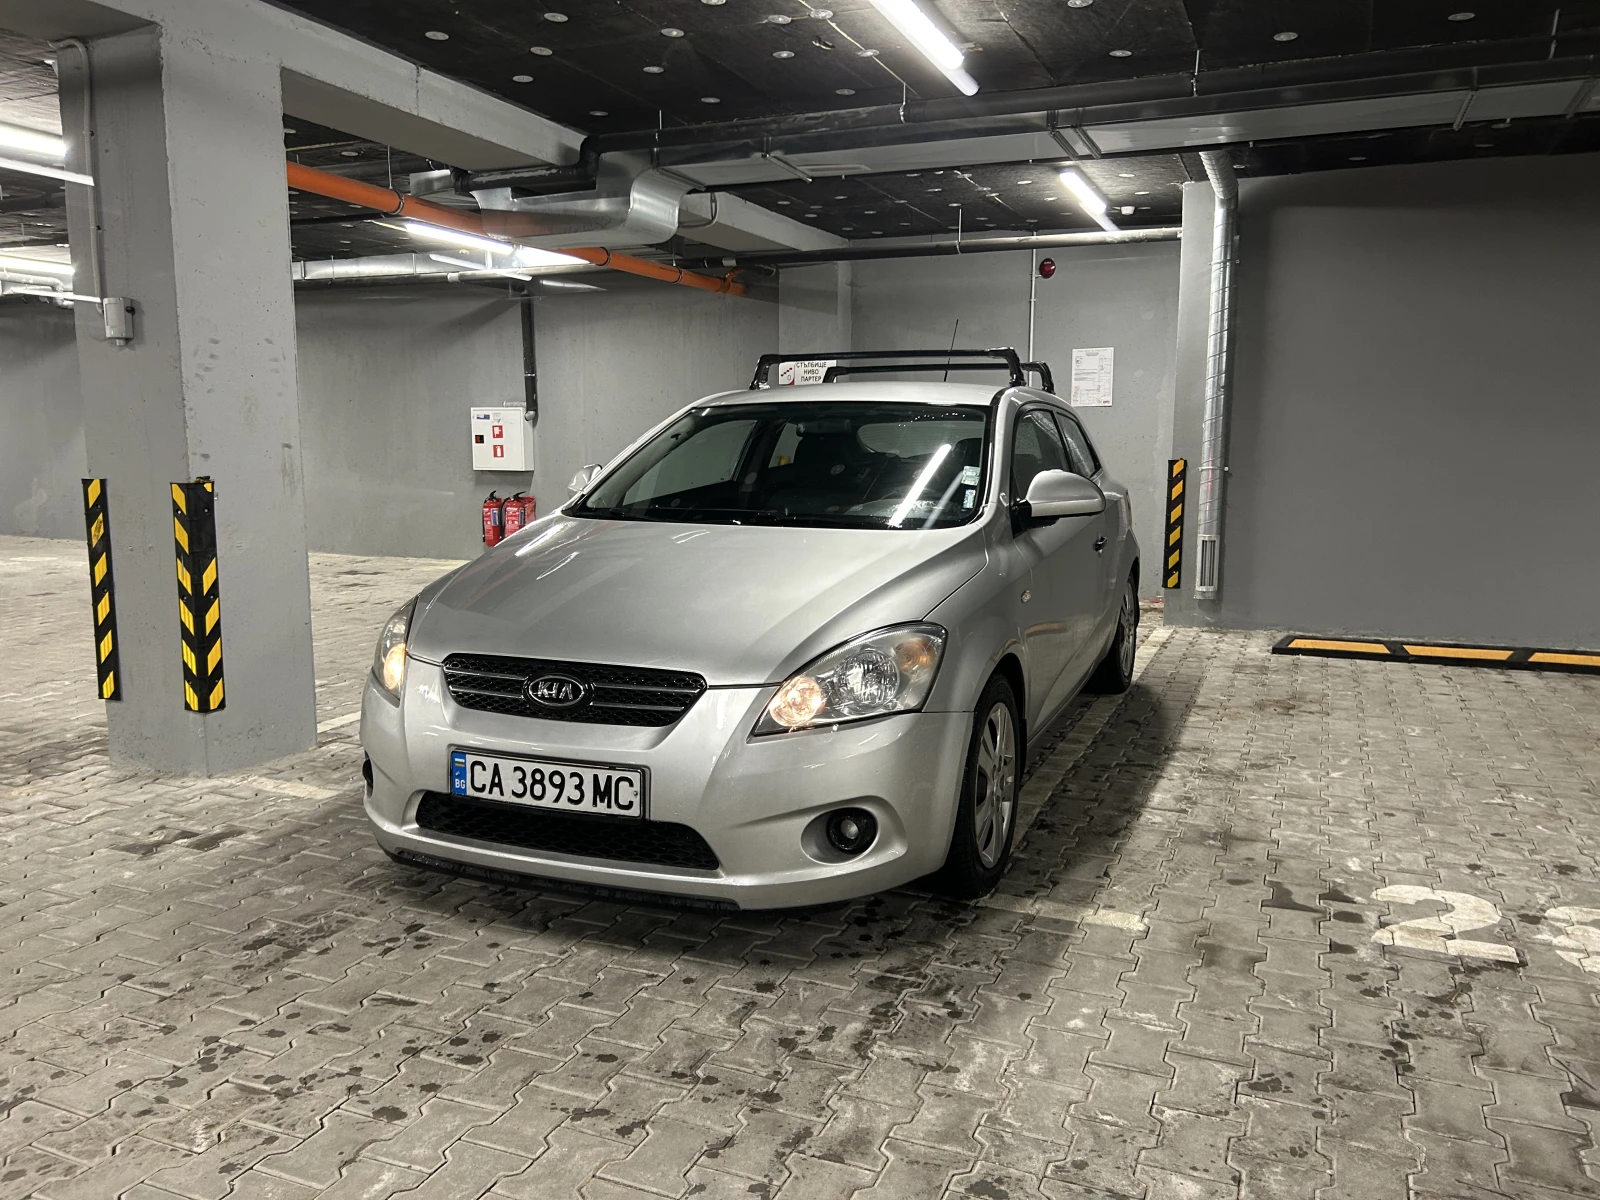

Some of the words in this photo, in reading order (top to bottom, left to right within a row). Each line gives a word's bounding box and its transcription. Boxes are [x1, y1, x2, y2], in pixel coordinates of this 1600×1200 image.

[536, 681, 574, 700] KIA
[455, 779, 466, 789] BG
[470, 760, 504, 797] CA
[511, 766, 585, 806] 3893
[592, 774, 634, 811] MC
